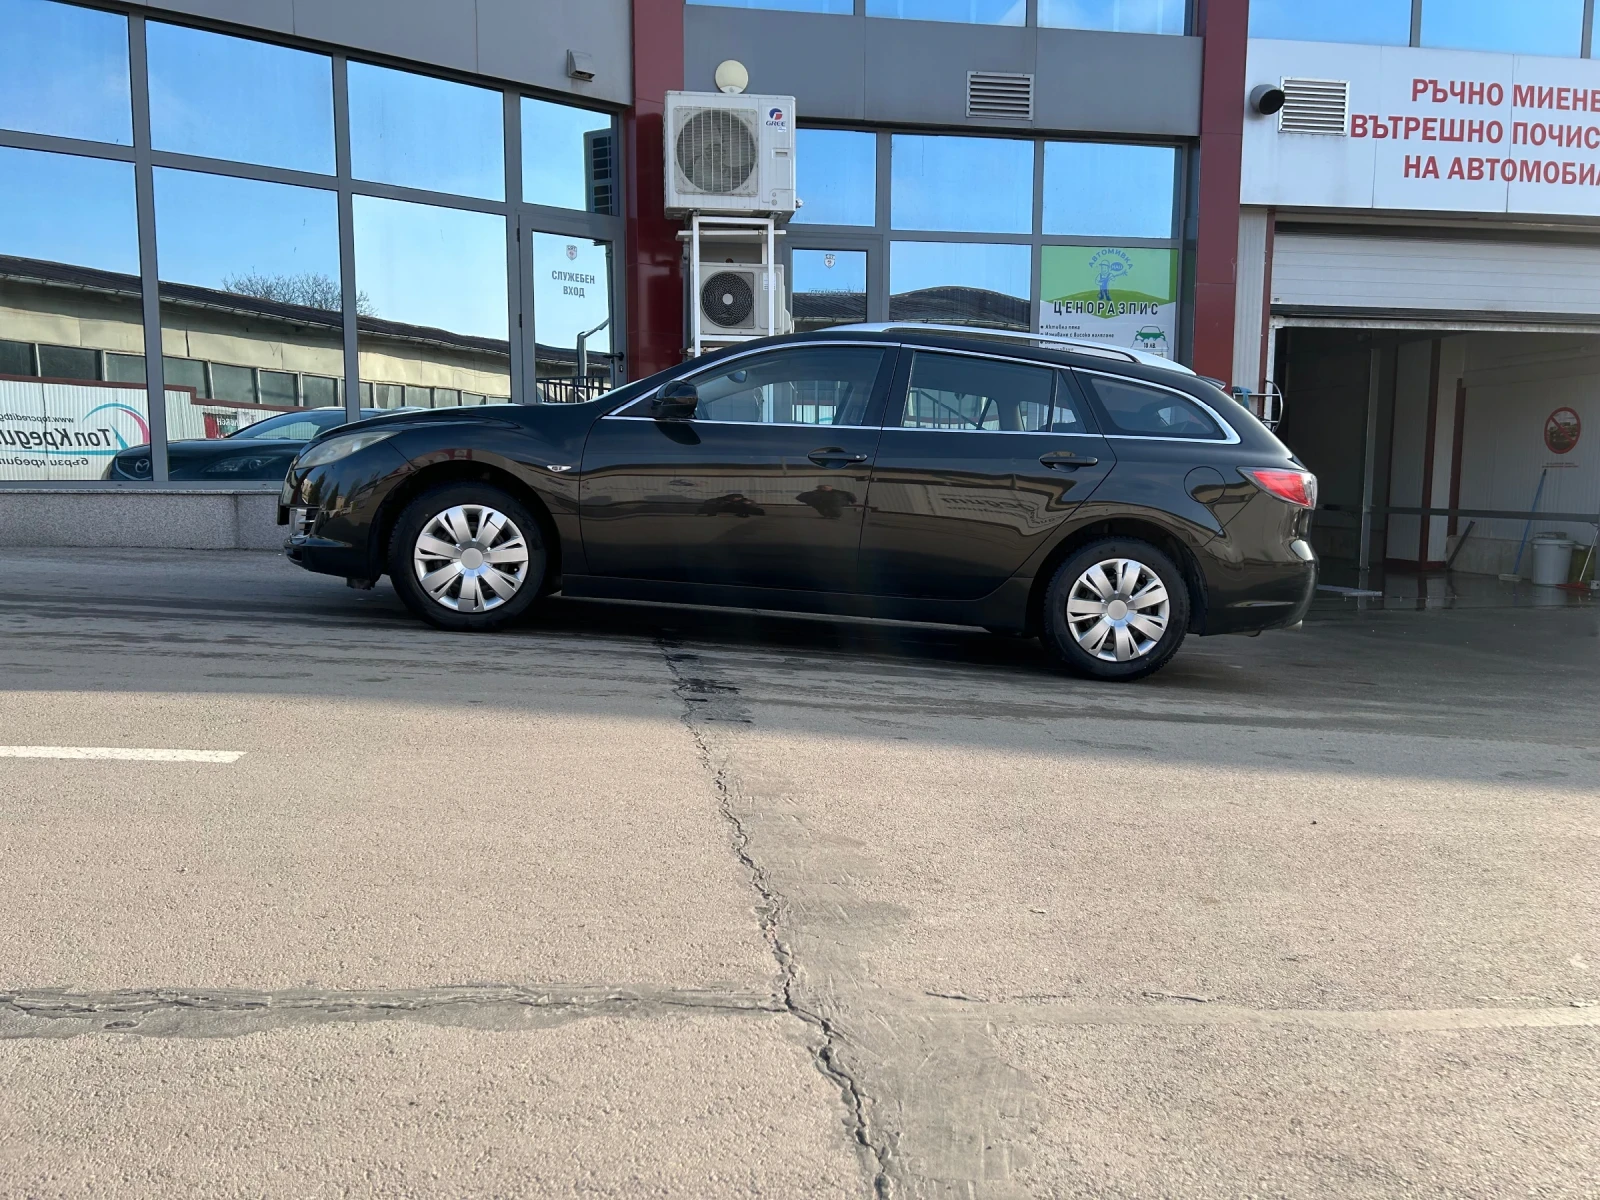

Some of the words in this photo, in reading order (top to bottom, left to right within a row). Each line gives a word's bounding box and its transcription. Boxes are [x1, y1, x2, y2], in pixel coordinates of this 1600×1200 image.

[1411, 78, 1504, 106] РЪЧНО
[1512, 84, 1600, 112] МИЕНЕ
[1350, 114, 1504, 144] ВЪТРЕШНО
[1403, 155, 1440, 179] НА
[1088, 248, 1133, 270] АВТОМИВКА
[551, 270, 595, 284] СЛУЖЕБЕН
[563, 285, 585, 298] ВХОД
[1053, 301, 1159, 316] ЦЕНОРАЗПИС
